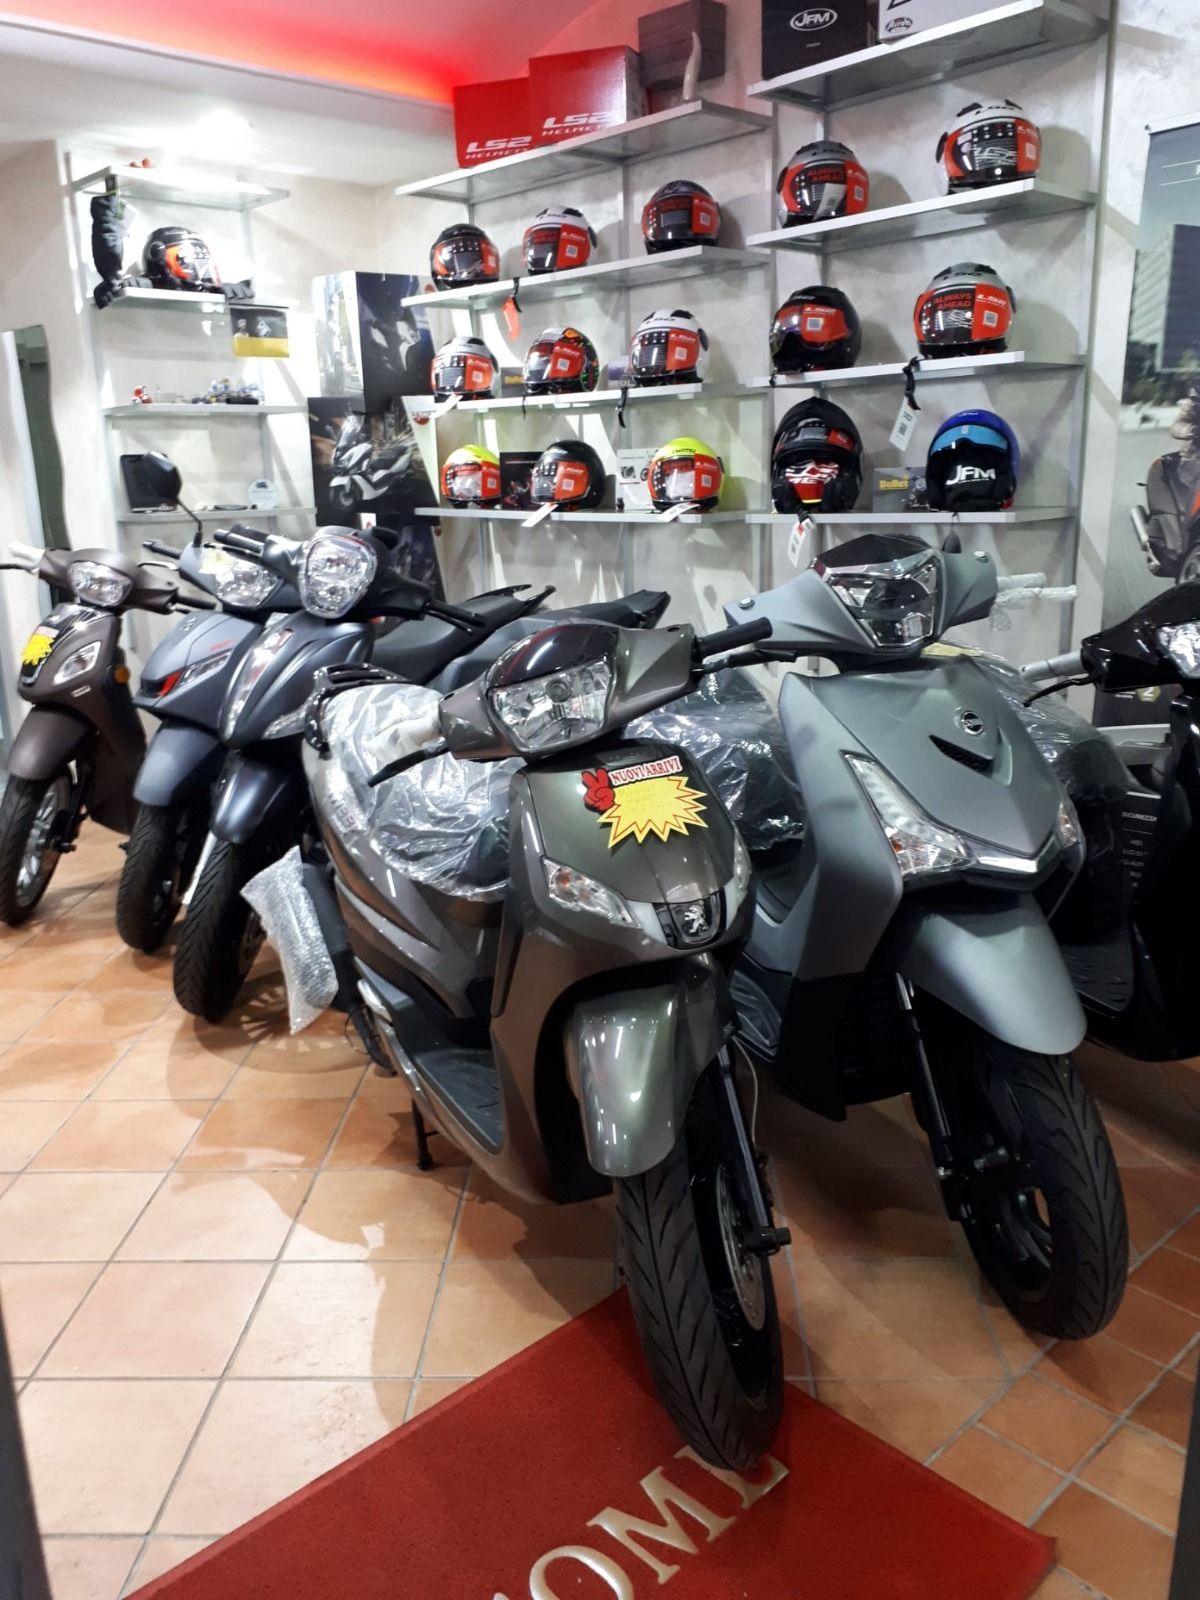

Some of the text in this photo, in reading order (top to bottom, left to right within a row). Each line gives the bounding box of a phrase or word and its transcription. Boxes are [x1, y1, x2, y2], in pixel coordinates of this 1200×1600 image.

[795, 12, 831, 28] JFM
[542, 111, 611, 129] LS2
[466, 136, 533, 154] LS2
[933, 292, 972, 303] ALWAYS
[937, 300, 972, 310] AHEAD
[946, 465, 996, 485] JFM
[610, 757, 681, 784] NUOVI ARRIVI
